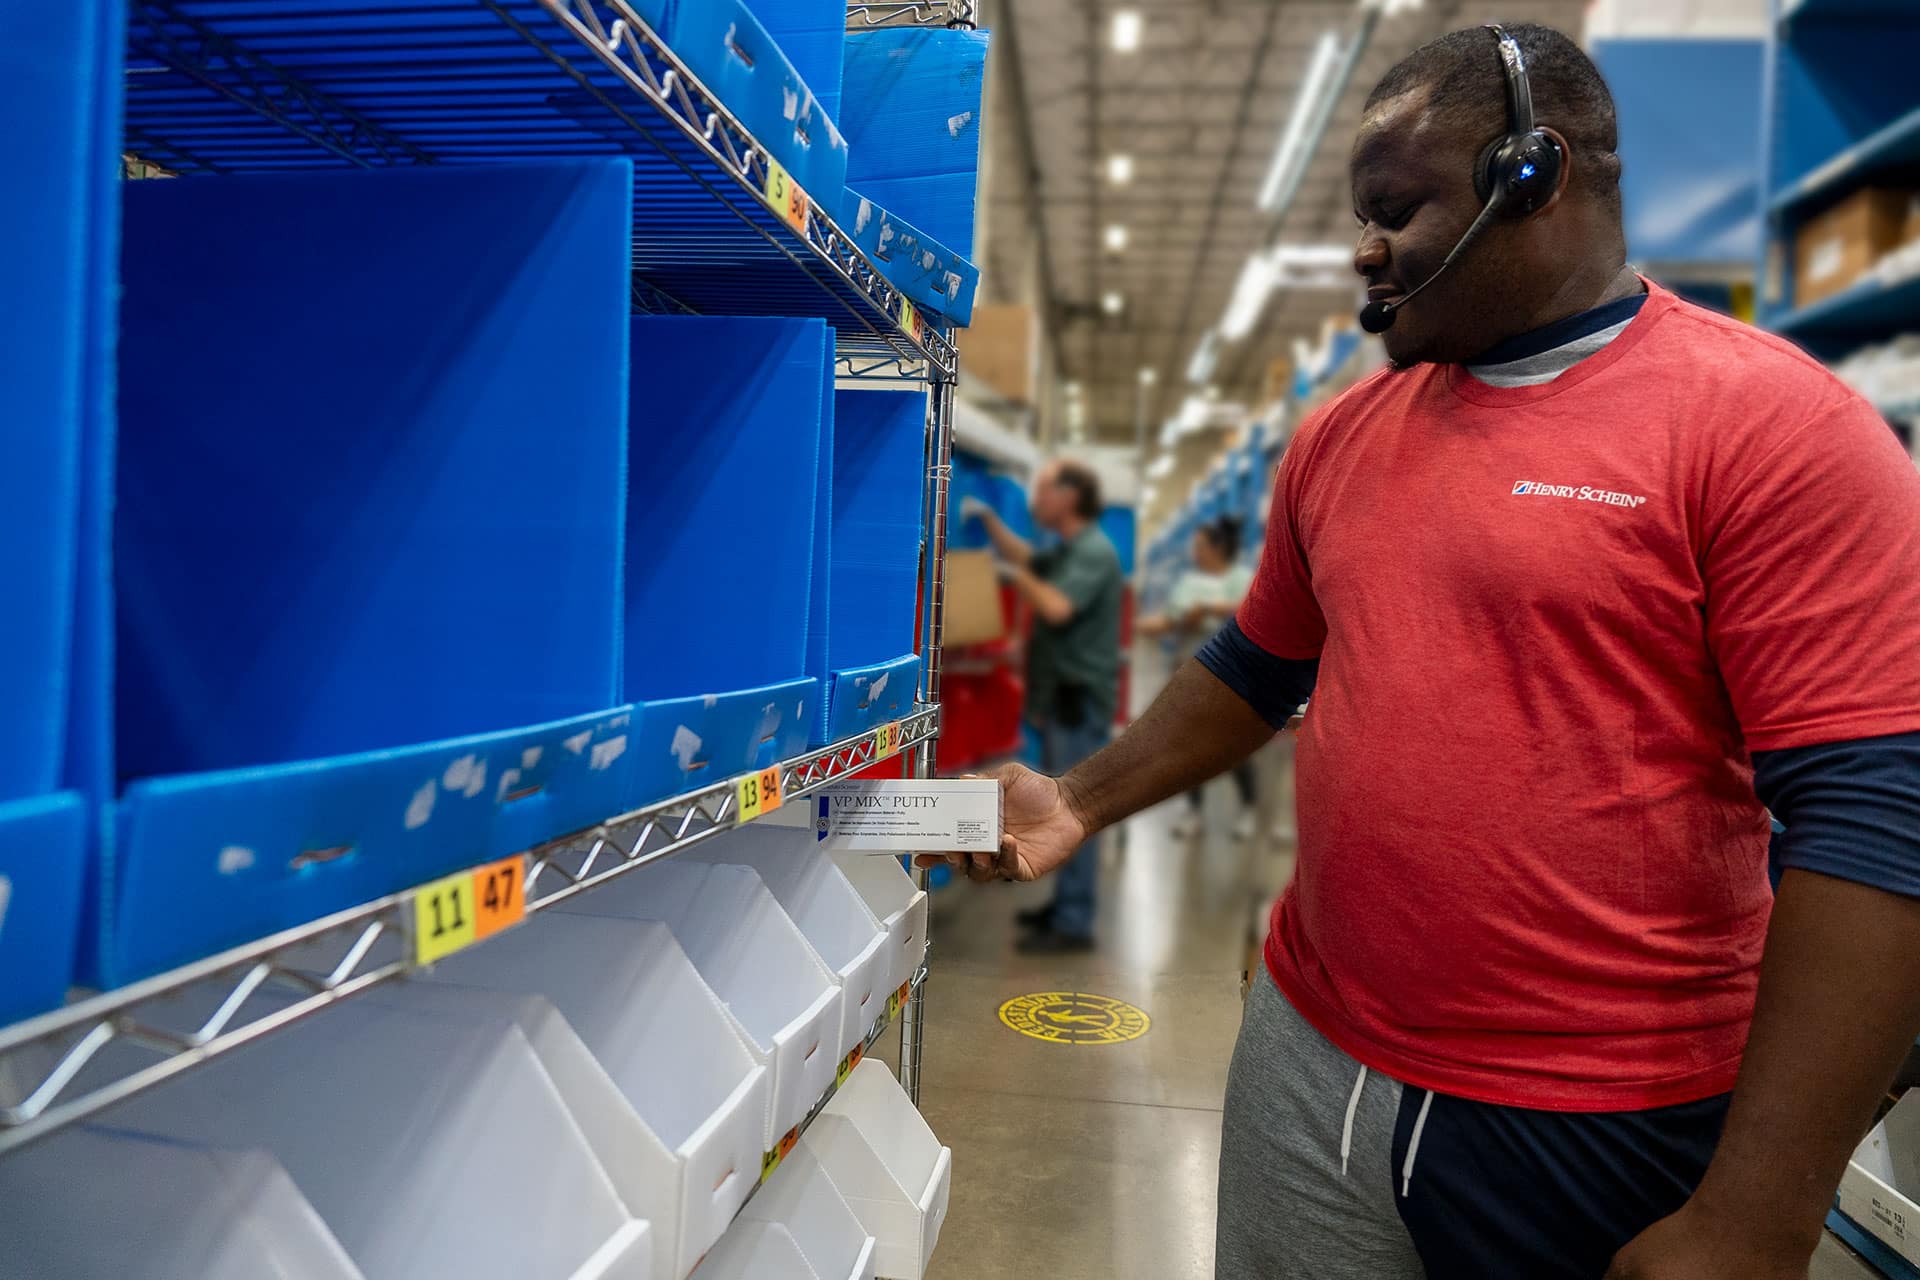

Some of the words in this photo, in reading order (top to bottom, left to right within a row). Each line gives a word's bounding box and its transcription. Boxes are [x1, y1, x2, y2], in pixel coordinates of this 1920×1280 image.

[775, 173, 783, 200] 5
[1526, 481, 1579, 498] HENRY
[879, 730, 887, 751] 15
[889, 725, 898, 747] 33
[743, 780, 758, 810] 13
[762, 773, 777, 801] 94
[834, 796, 853, 808] VP
[893, 796, 940, 808] PUTTY
[430, 888, 466, 938] 11
[483, 866, 516, 912] 47
